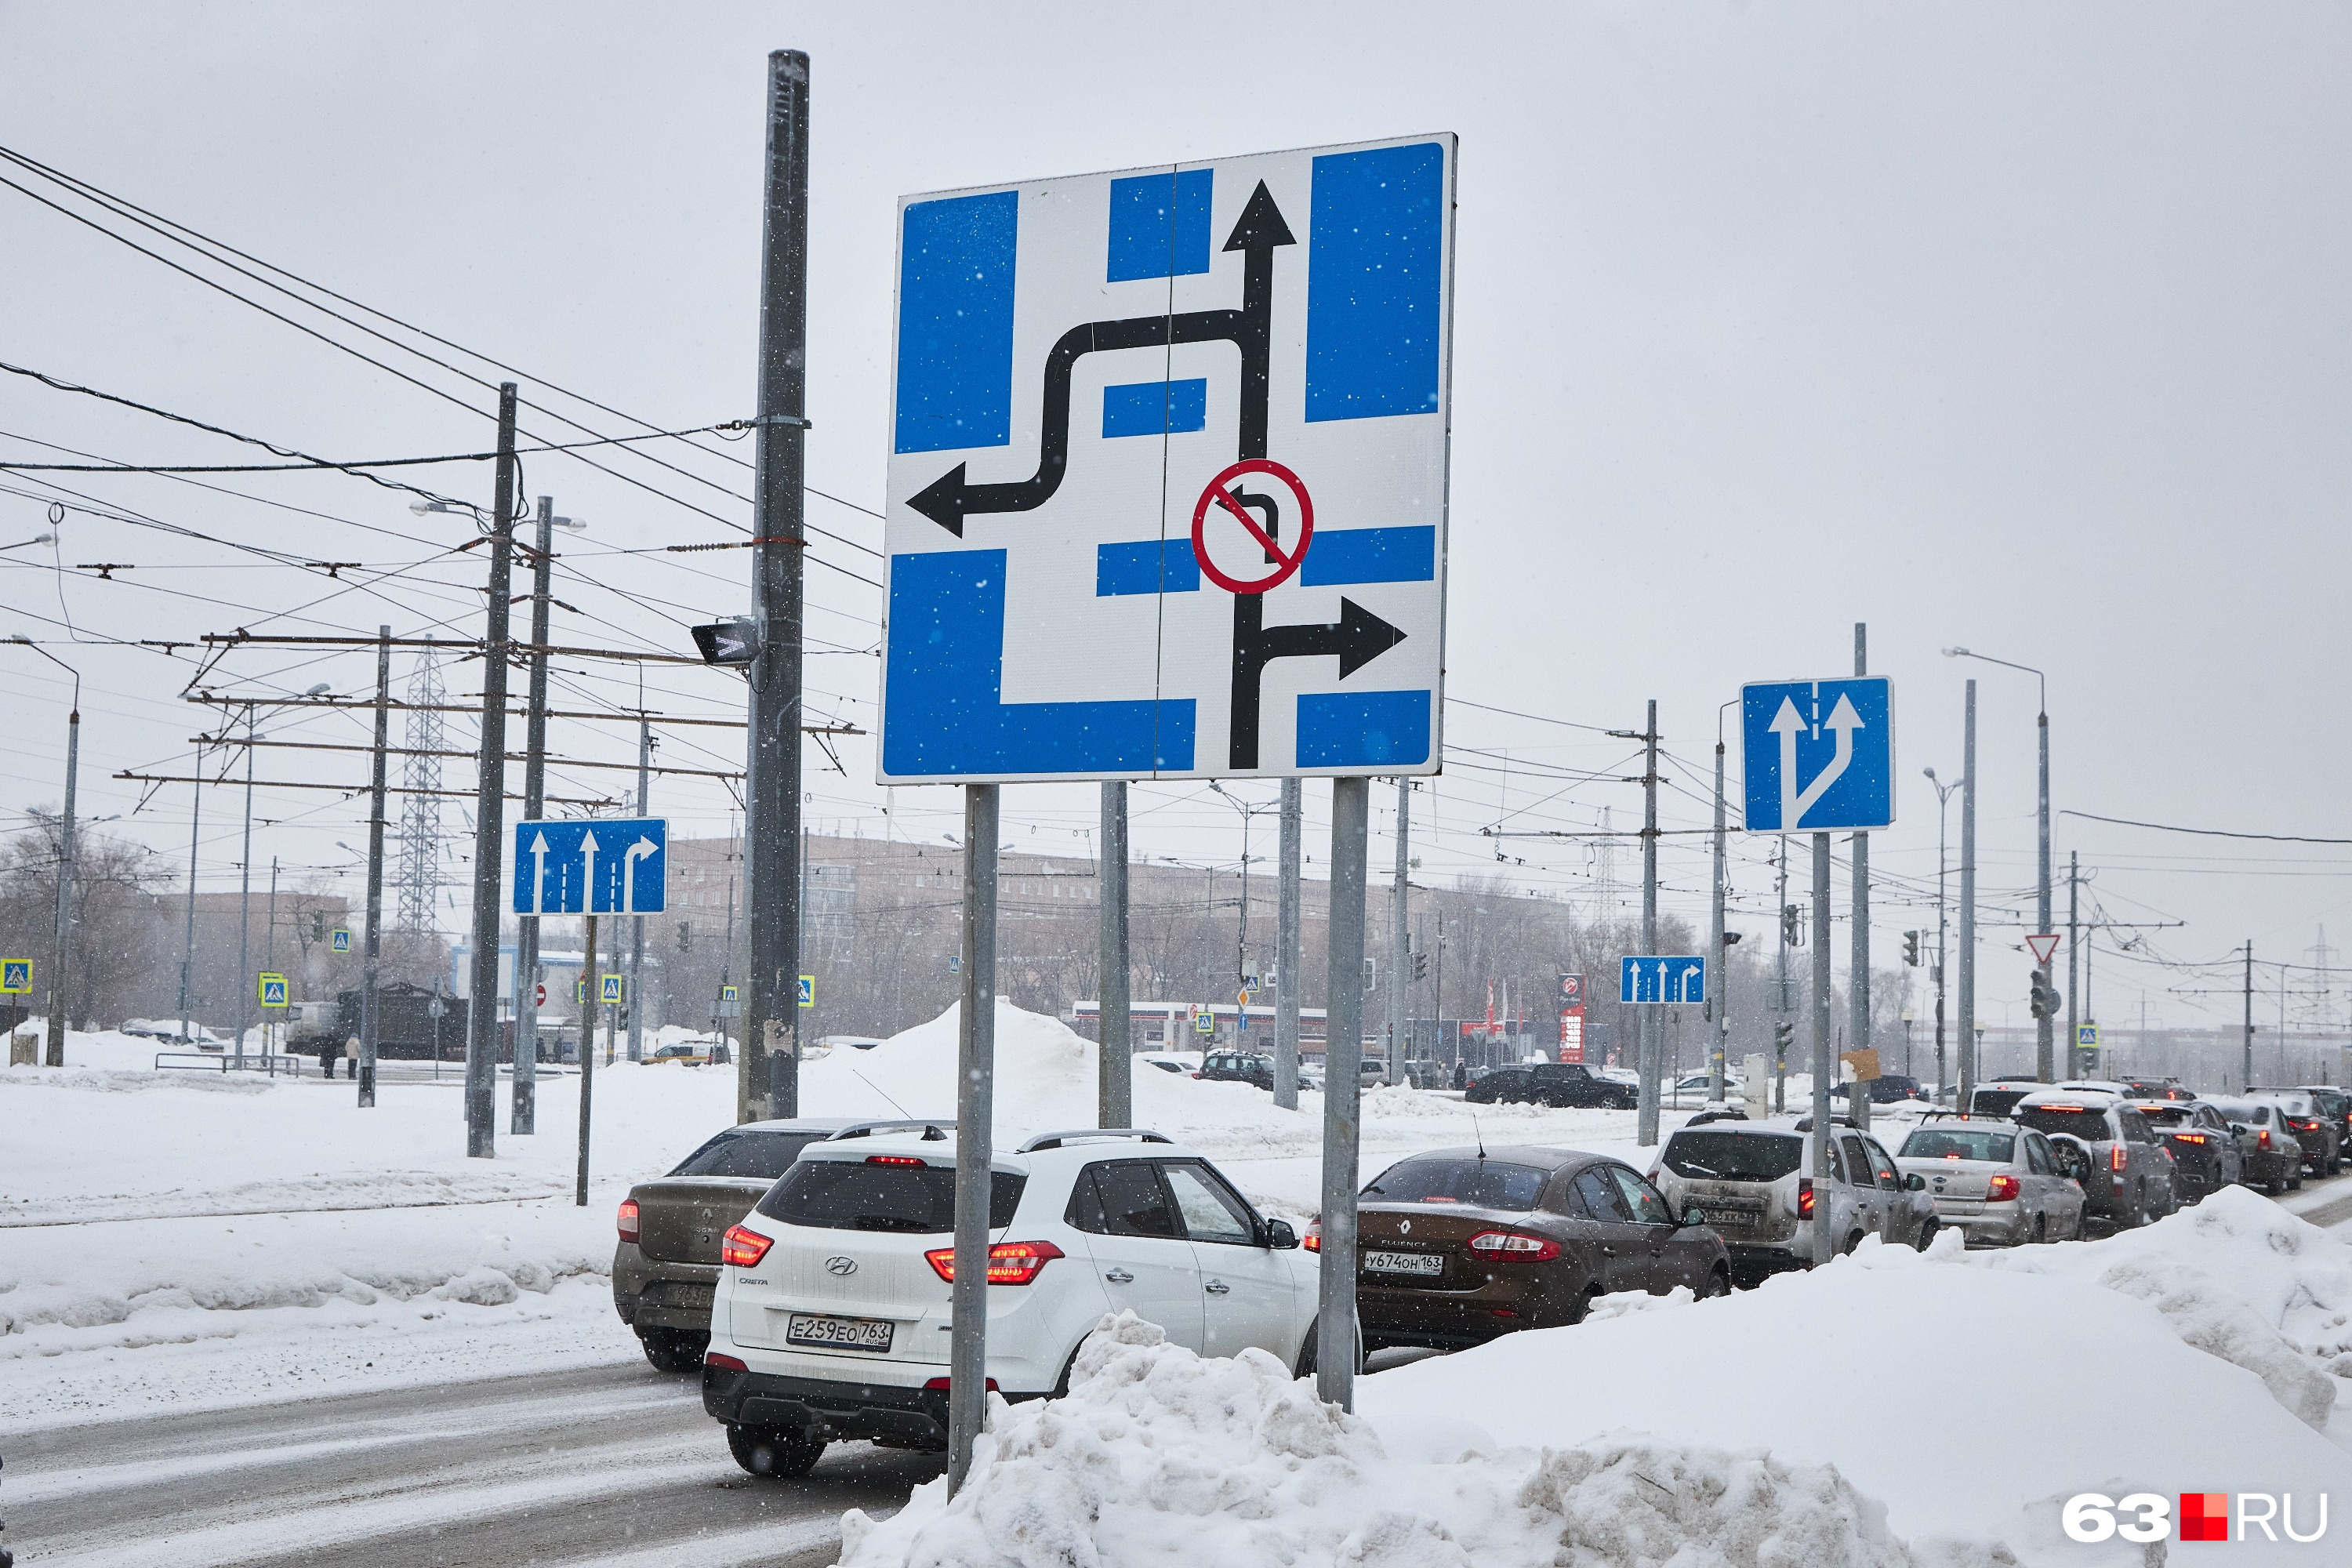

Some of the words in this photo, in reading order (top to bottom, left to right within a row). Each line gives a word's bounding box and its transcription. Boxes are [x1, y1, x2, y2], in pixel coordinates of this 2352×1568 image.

[1421, 1256, 1440, 1268] 163
[793, 1320, 858, 1341] Е259ЕО
[861, 1323, 887, 1339] 763
